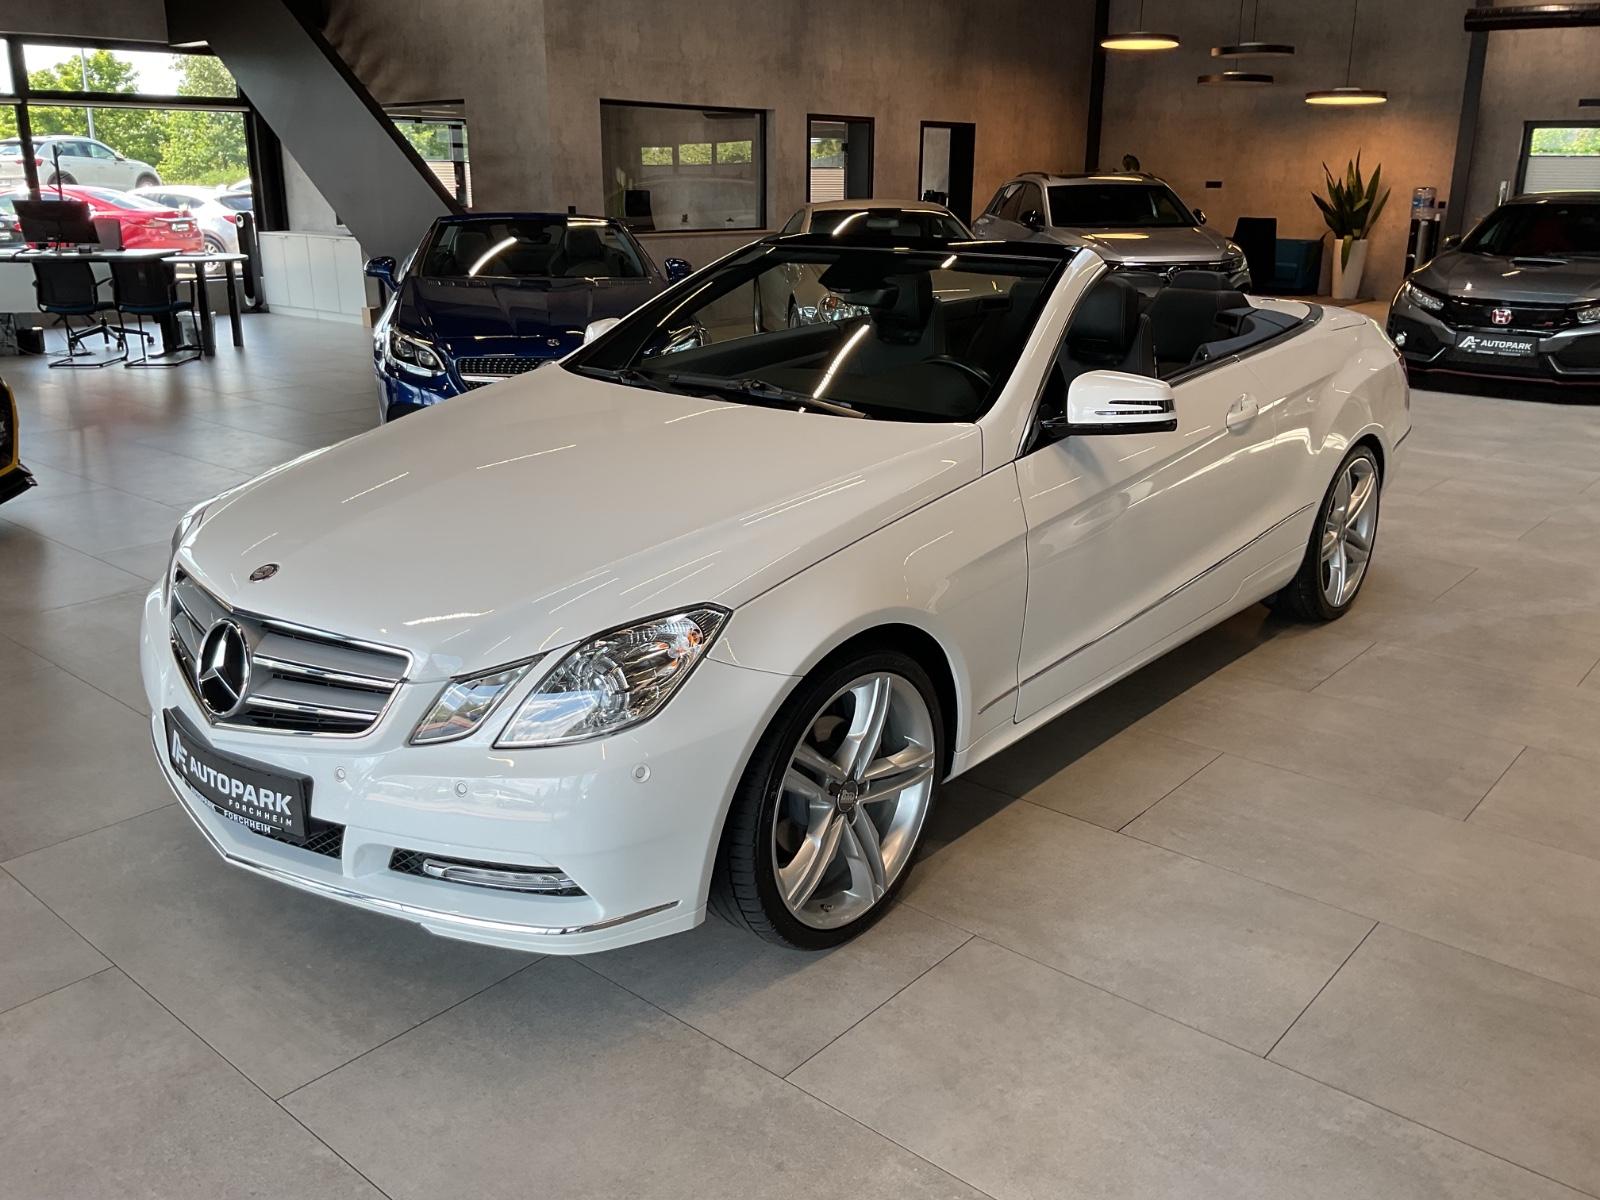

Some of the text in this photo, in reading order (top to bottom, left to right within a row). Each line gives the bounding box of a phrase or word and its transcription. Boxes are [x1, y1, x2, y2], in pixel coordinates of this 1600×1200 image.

[1480, 340, 1532, 350] AUTOPARK
[190, 756, 292, 815] AUTOPARK
[223, 810, 271, 833] FORCHHEIM
[228, 798, 292, 826] FORCHHEIM
